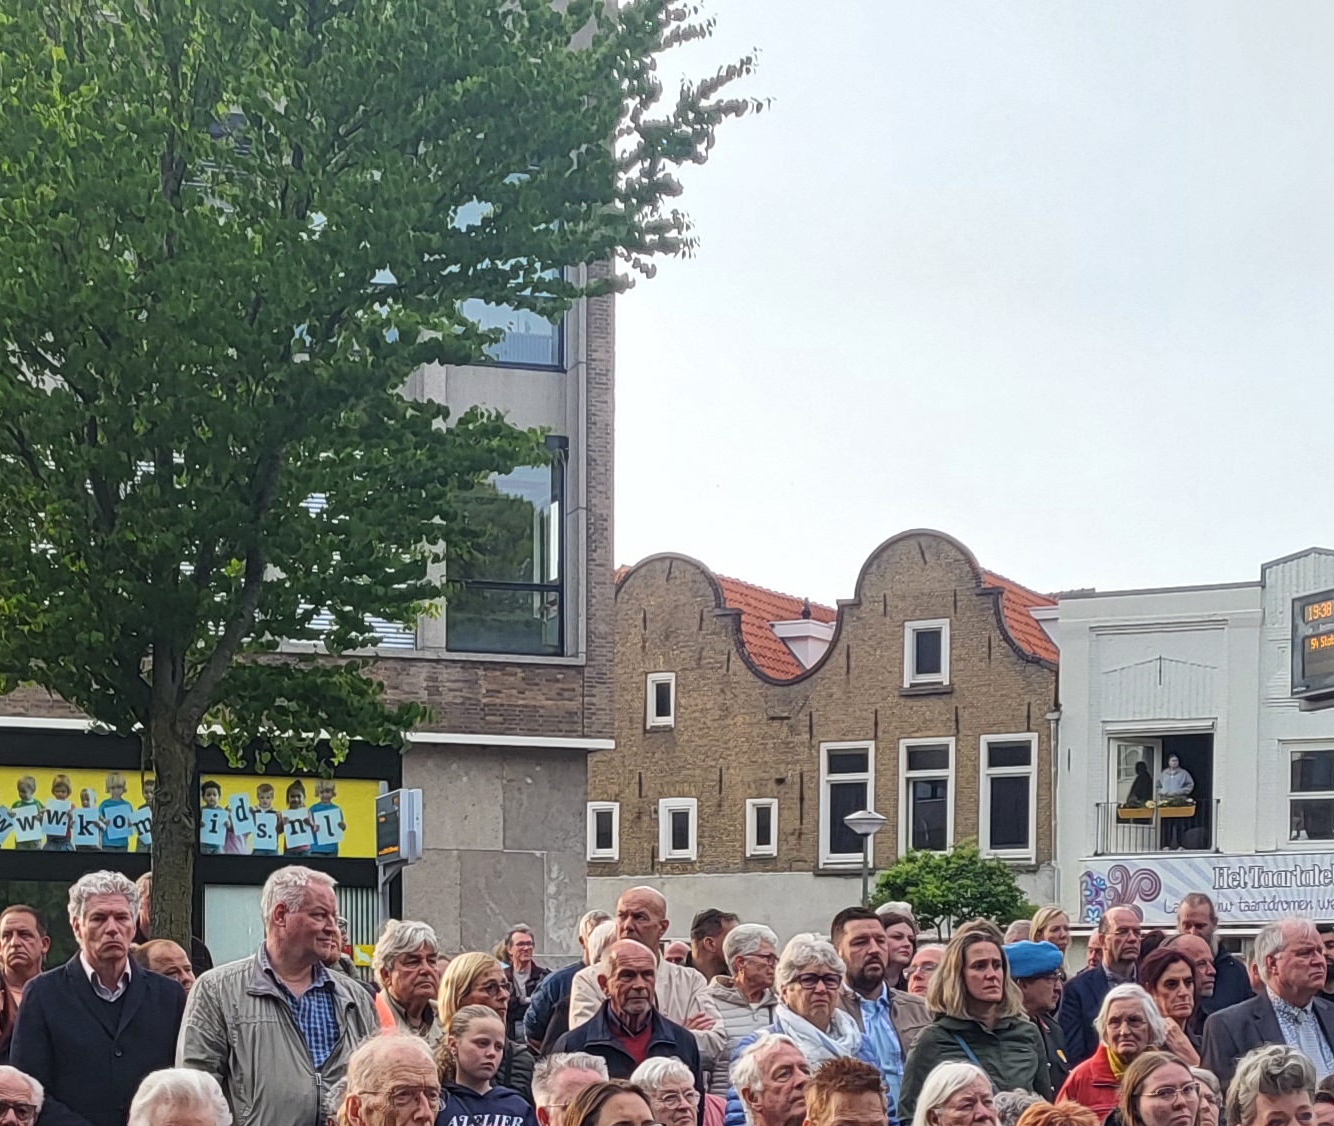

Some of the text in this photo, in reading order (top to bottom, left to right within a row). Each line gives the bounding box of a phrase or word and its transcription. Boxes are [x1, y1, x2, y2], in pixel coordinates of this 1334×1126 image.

[1308, 601, 1334, 620] 19:38
[1212, 867, 1248, 890] Het
[1238, 894, 1313, 912] taartdromen
